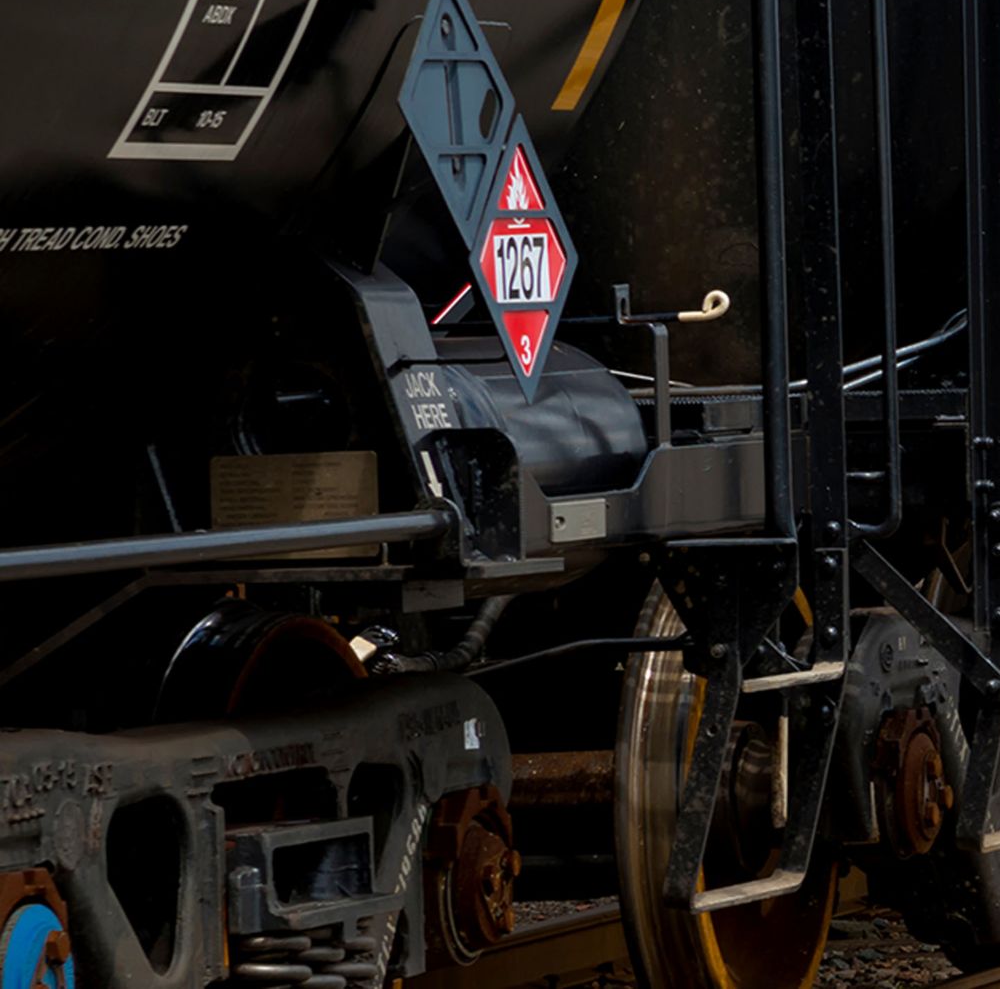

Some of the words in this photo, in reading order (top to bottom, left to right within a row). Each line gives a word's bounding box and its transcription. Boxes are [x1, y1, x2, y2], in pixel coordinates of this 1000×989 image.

[141, 108, 169, 127] BLT
[195, 109, 227, 128] 10-15
[10, 227, 77, 252] TREAD
[70, 225, 128, 251] COND.
[123, 224, 189, 250] SHOES
[496, 235, 546, 301] 1267
[520, 334, 532, 365] 3
[405, 370, 442, 400] JACK
[411, 403, 453, 430] HERE
